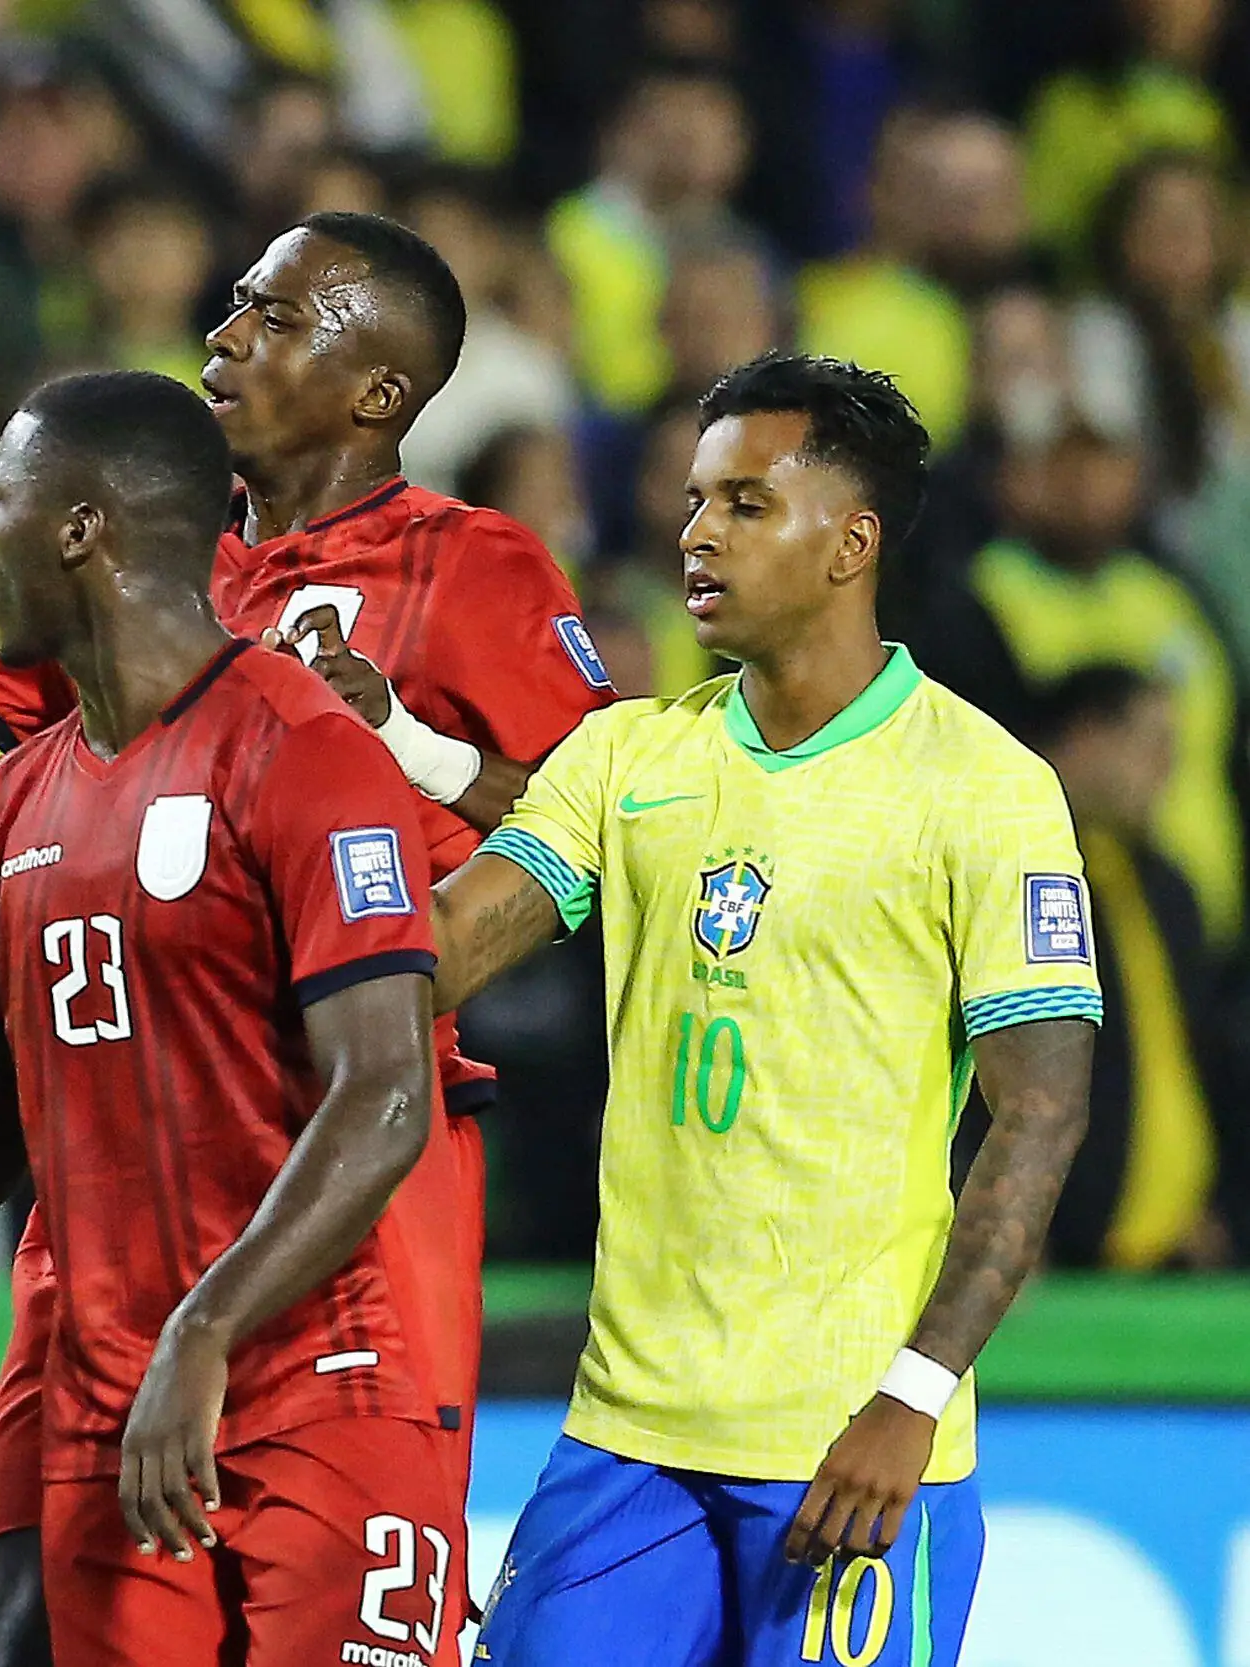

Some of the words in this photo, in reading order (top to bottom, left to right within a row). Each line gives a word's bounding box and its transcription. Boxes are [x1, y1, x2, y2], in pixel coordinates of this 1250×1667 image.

[1, 844, 63, 878] arathon
[719, 900, 744, 913] CBF
[43, 914, 131, 1045] 23
[672, 1012, 745, 1133] 10
[359, 1514, 451, 1656] 23
[801, 1550, 894, 1667] 10
